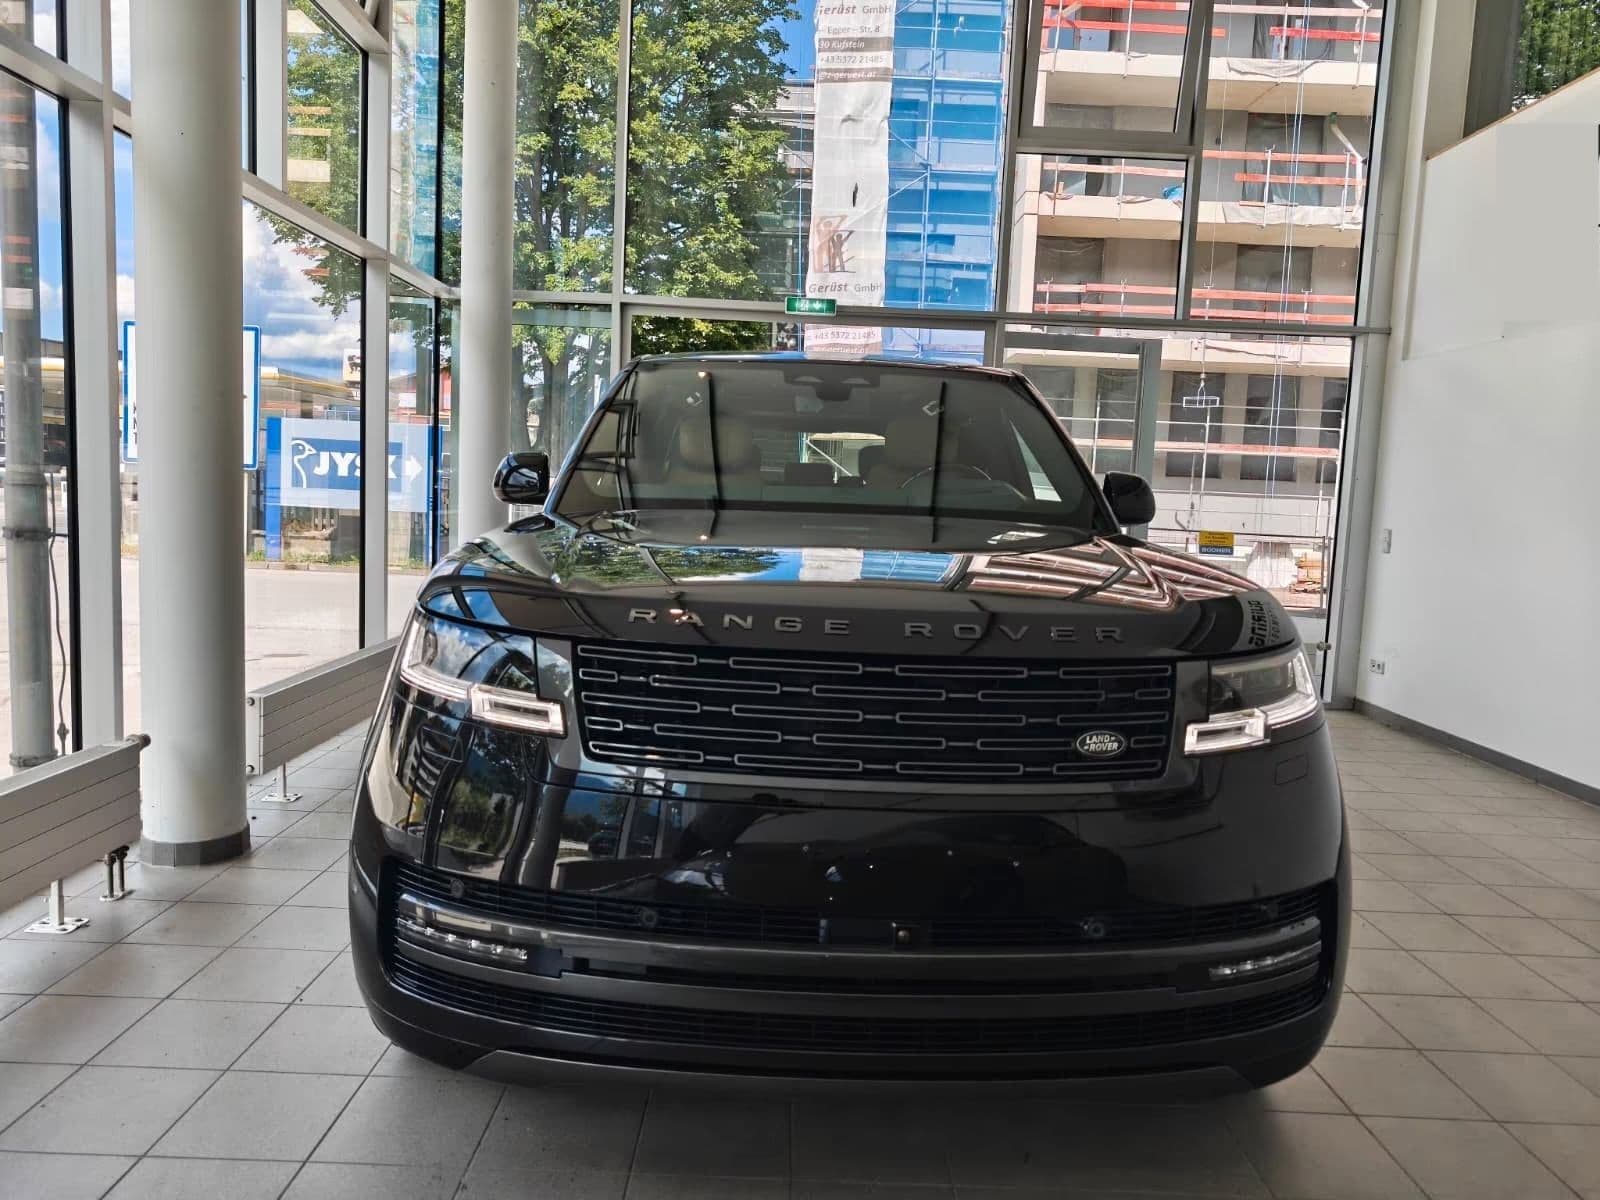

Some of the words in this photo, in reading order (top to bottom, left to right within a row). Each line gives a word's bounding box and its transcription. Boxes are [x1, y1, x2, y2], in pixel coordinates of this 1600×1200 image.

[831, 40, 865, 51] Kufstein
[808, 281, 848, 294] Gerüst
[854, 282, 882, 293] GmbH
[628, 607, 850, 635] RANGE
[903, 621, 1124, 643] ROVER
